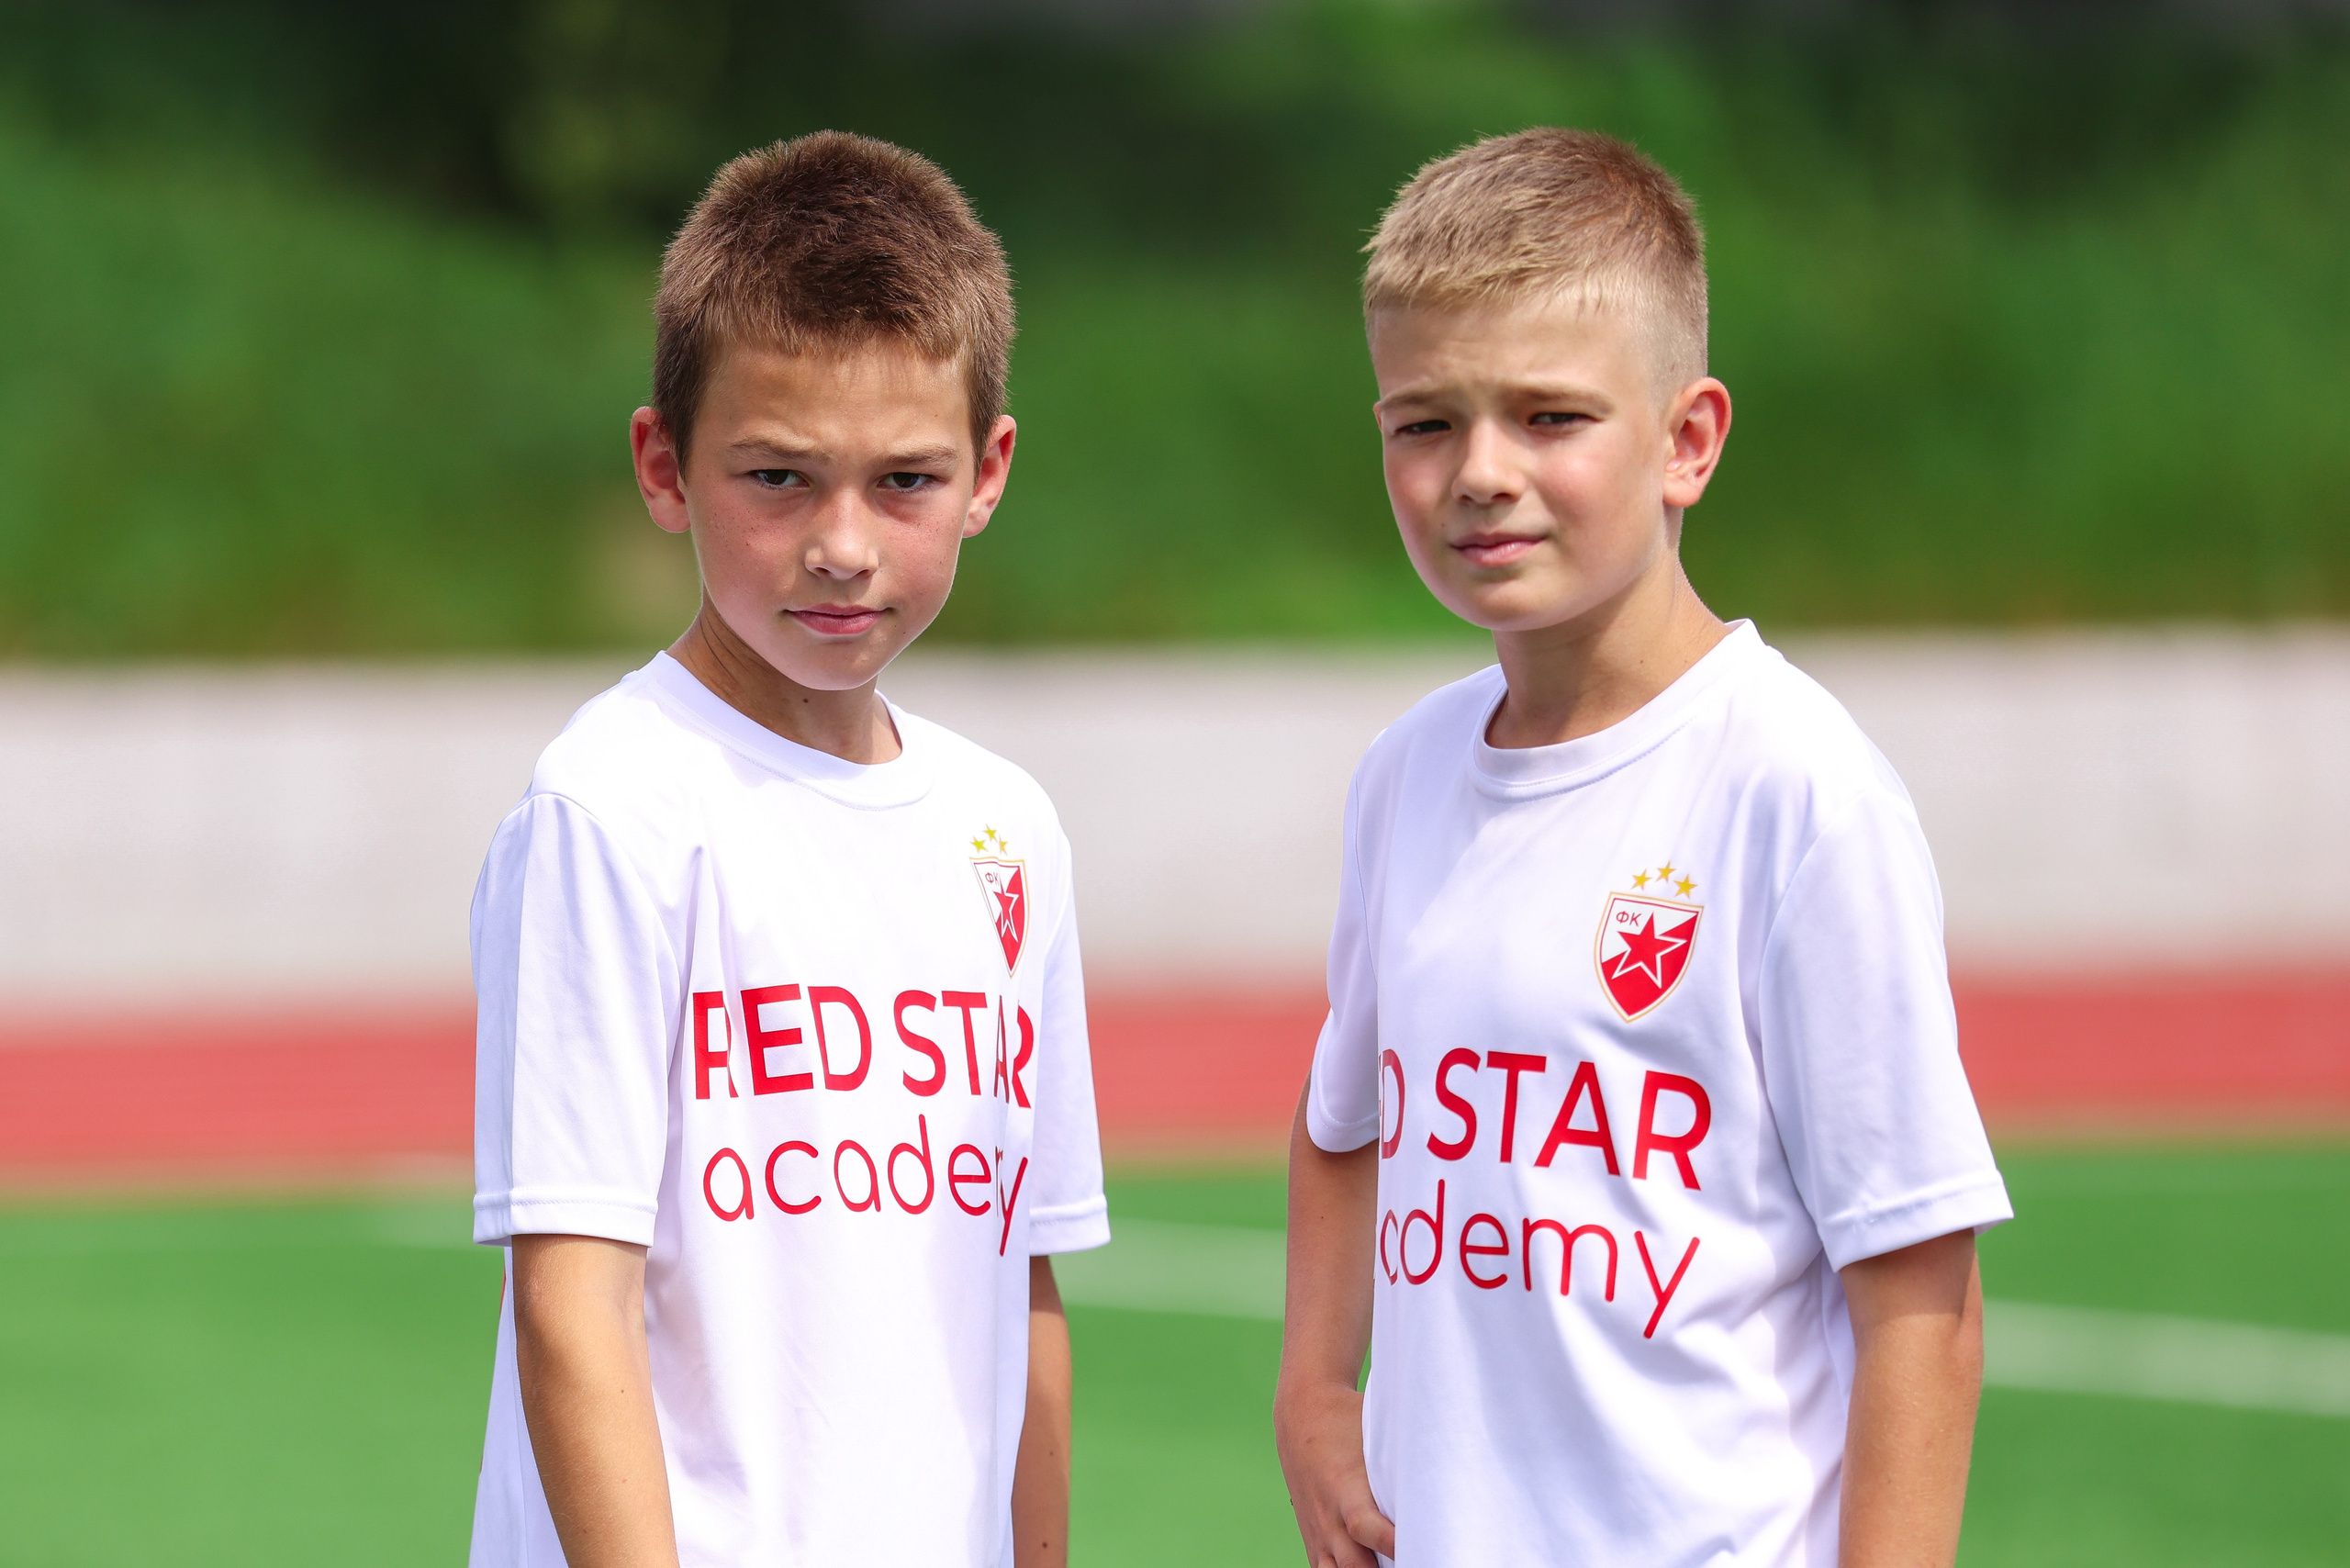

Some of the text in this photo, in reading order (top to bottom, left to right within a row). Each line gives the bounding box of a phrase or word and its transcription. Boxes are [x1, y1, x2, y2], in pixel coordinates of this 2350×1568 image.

[1616, 911, 1642, 927] ФК
[692, 983, 1035, 1109] RED STAR
[1426, 1047, 1712, 1192] STAR
